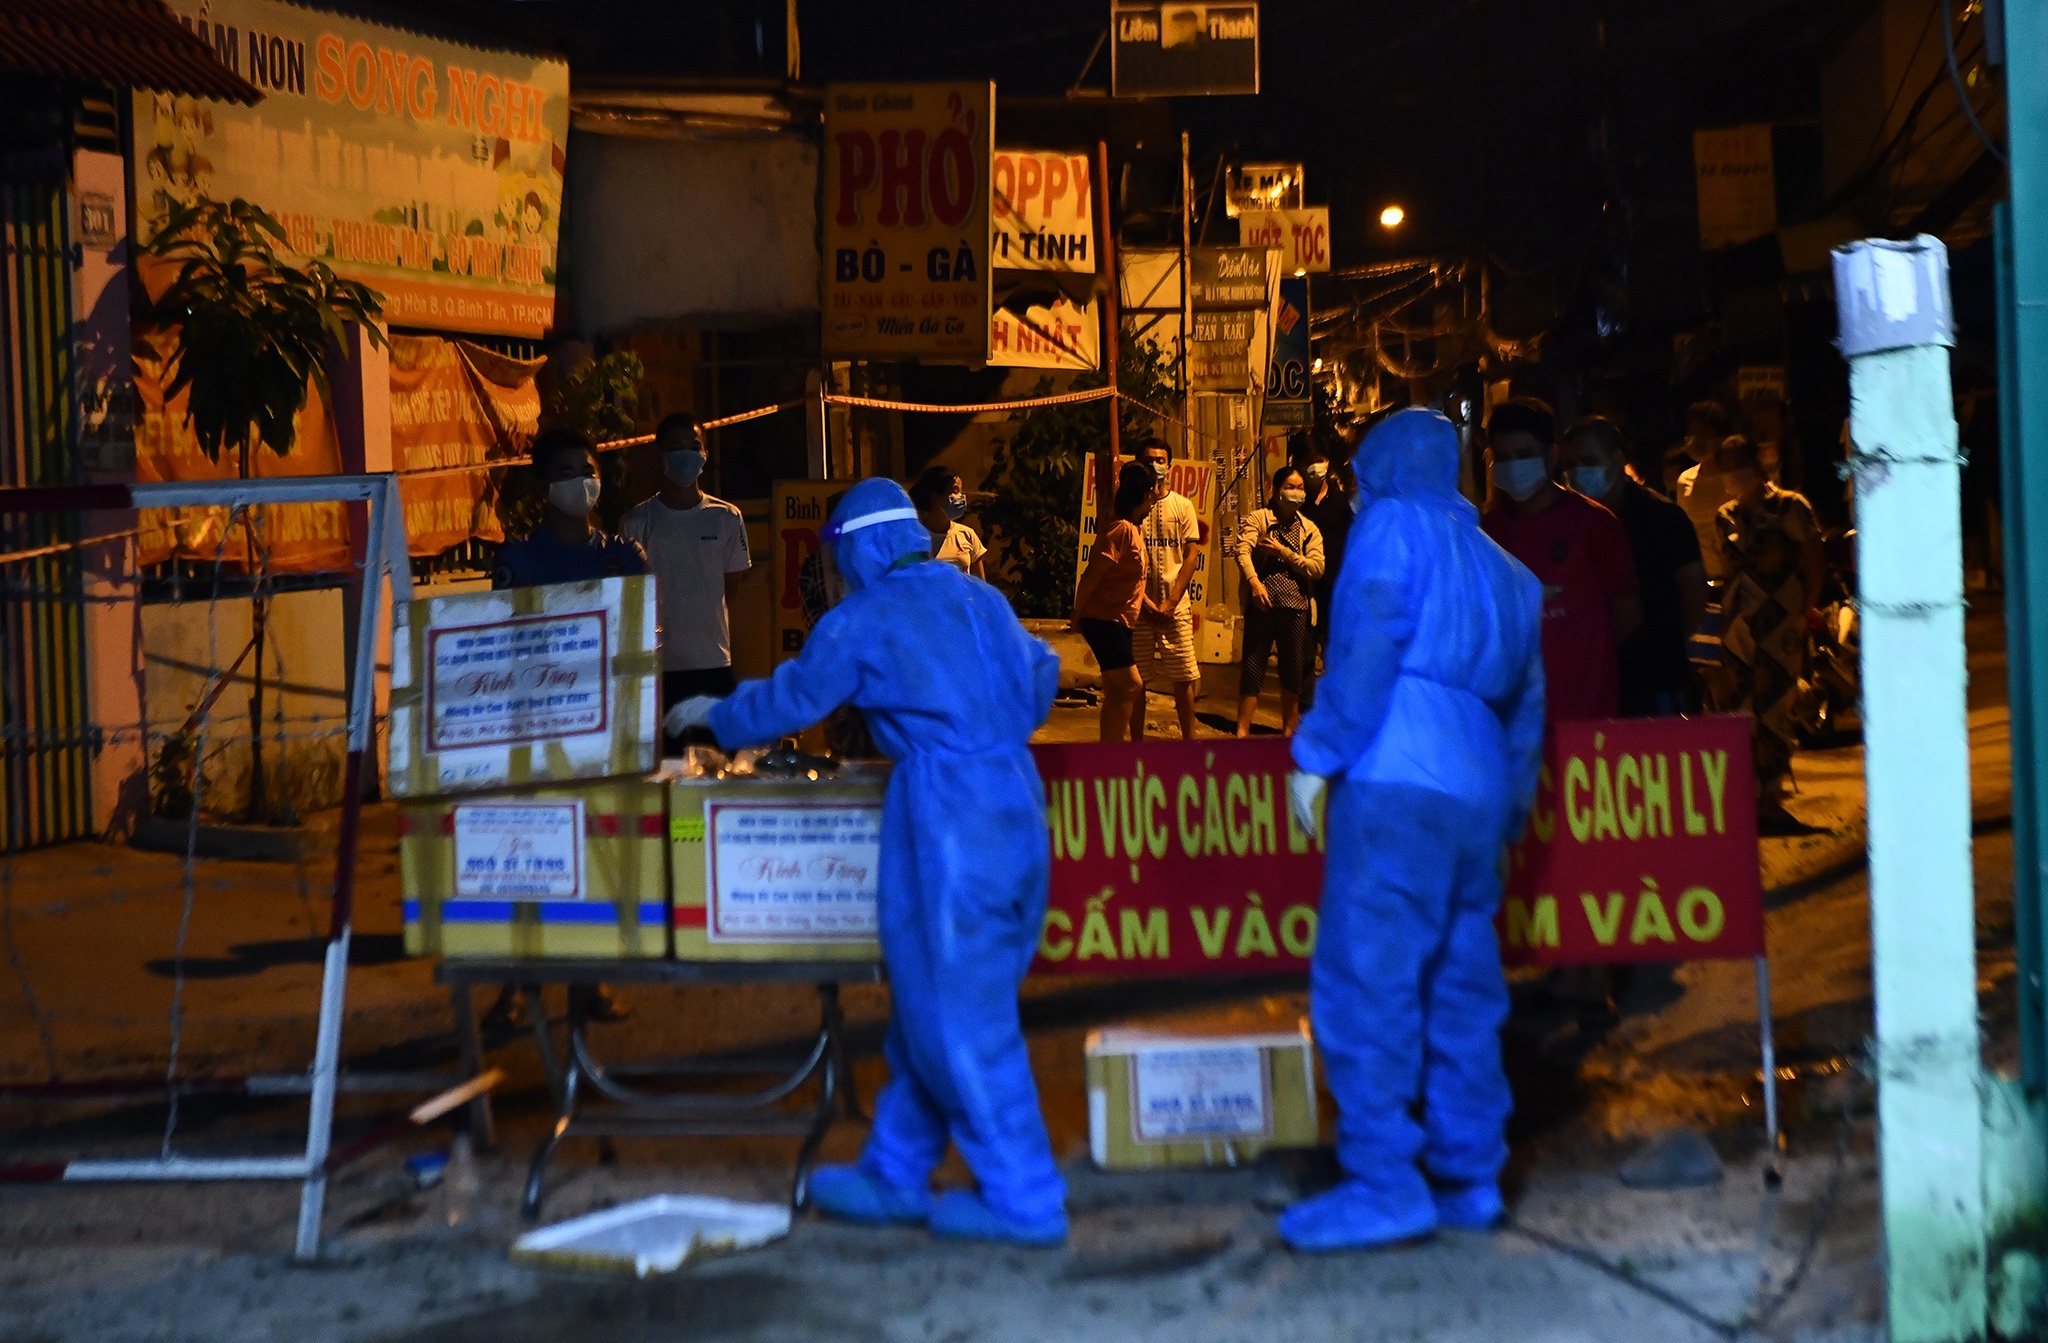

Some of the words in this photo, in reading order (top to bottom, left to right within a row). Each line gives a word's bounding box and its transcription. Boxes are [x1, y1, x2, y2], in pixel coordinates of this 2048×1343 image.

[249, 31, 305, 95] NON
[316, 34, 438, 122] SONG
[447, 64, 545, 145] NGHI
[836, 91, 976, 226] PHỞ
[994, 154, 1090, 220] OPPY
[836, 240, 885, 283] BÒ
[927, 240, 977, 283] GÀ
[1019, 226, 1087, 261] TÍNH
[1291, 215, 1325, 266] TÓC
[785, 496, 821, 519] Bình
[1170, 464, 1210, 511] OPY
[1047, 779, 1086, 861] HU
[1094, 759, 1168, 883] VỰC
[1176, 751, 1276, 859] CÁCH
[1563, 731, 1673, 844] CÁCH
[1680, 749, 1727, 836] LY
[1037, 886, 1171, 961] CẤM
[1189, 891, 1318, 959] VÀO
[1579, 875, 1726, 946] VÀO
